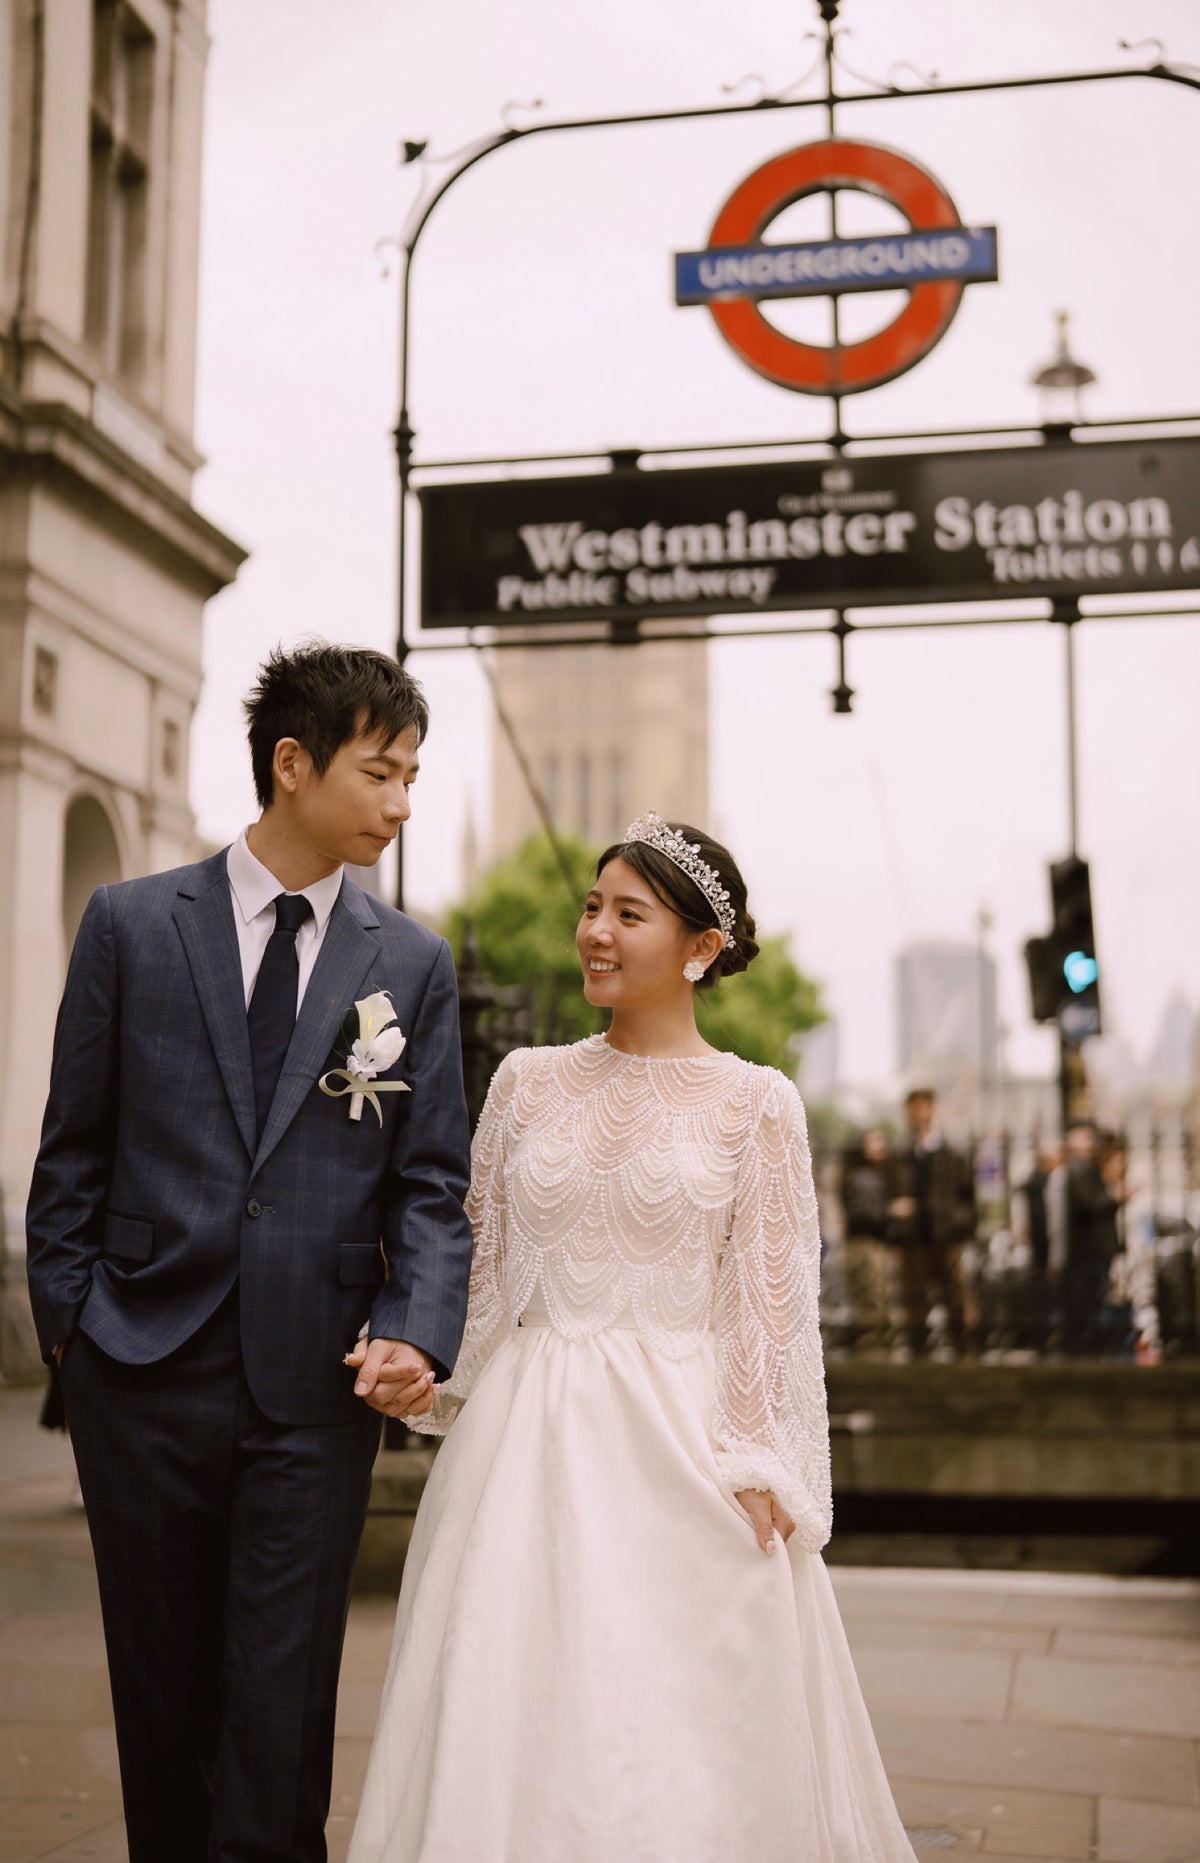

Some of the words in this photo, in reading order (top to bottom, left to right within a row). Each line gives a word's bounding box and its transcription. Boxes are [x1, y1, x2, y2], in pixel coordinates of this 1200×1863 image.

[699, 235, 970, 288] UNDERGROUND
[519, 510, 915, 572] Westminster
[934, 490, 1171, 550] Station
[497, 572, 617, 611] Public
[625, 564, 775, 605] Subway
[988, 543, 1122, 582] Toilets
